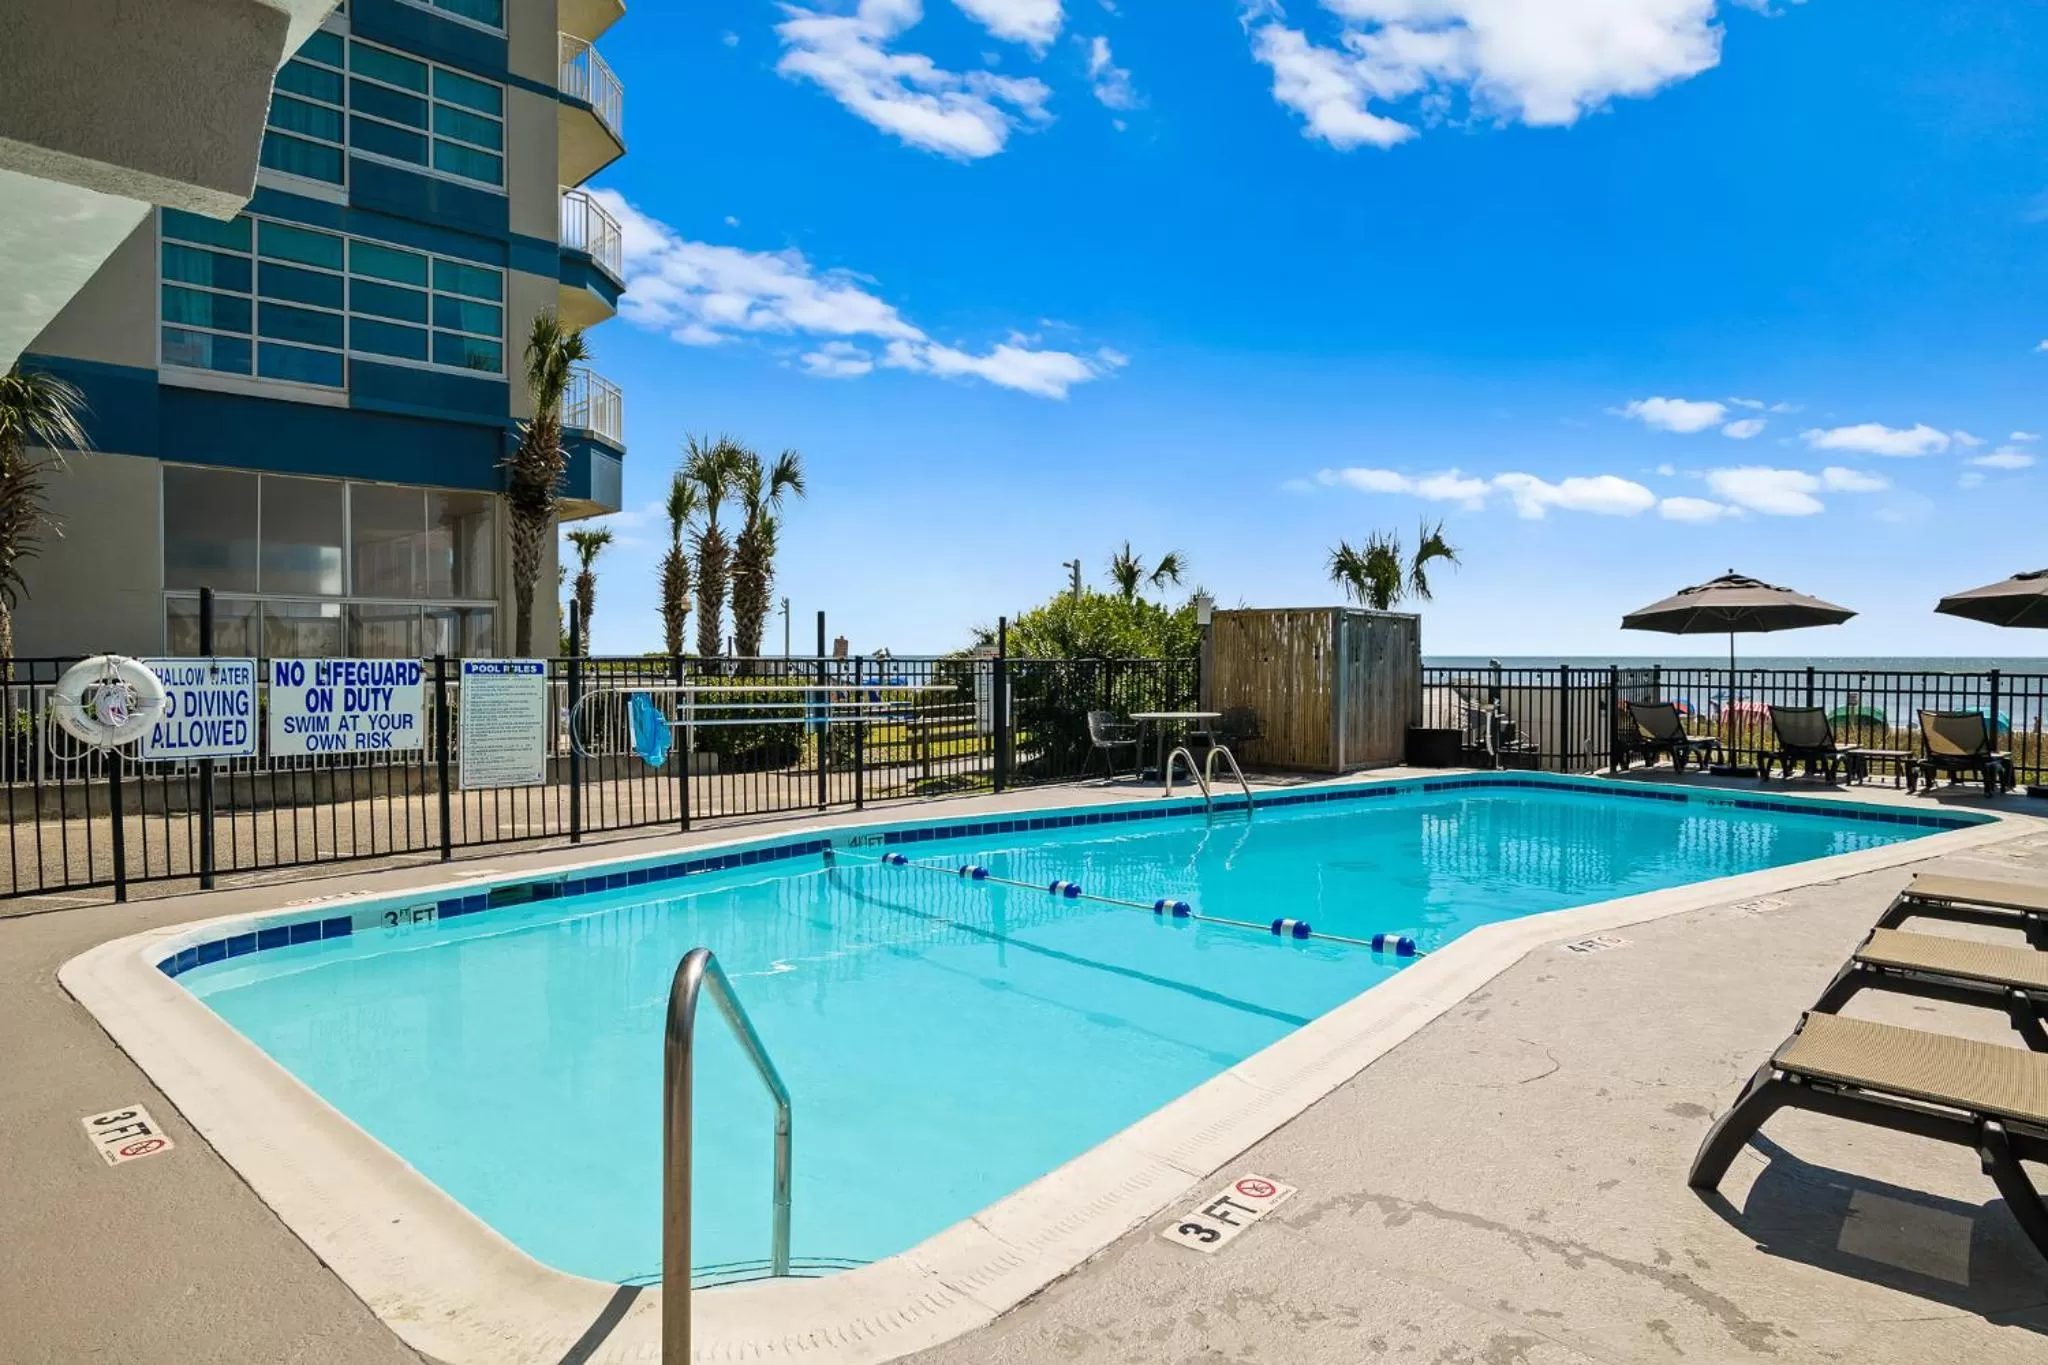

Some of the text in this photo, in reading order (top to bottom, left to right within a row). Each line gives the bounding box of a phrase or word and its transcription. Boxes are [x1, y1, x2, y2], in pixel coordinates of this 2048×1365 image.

[149, 667, 205, 686] HALLOW
[275, 661, 421, 687] NO LIFEGUARD
[472, 664, 501, 673] POOL
[163, 689, 249, 718] O DIVING
[305, 687, 394, 713] ON DUTY
[151, 720, 248, 749] ALLOWED
[284, 713, 413, 734] SWIM AT YOUR
[306, 732, 393, 752] OWN RISK
[413, 907, 436, 924] FT
[93, 1111, 153, 1145] 3 FT
[1178, 1223, 1221, 1243] 3
[1201, 1195, 1258, 1227] FT
